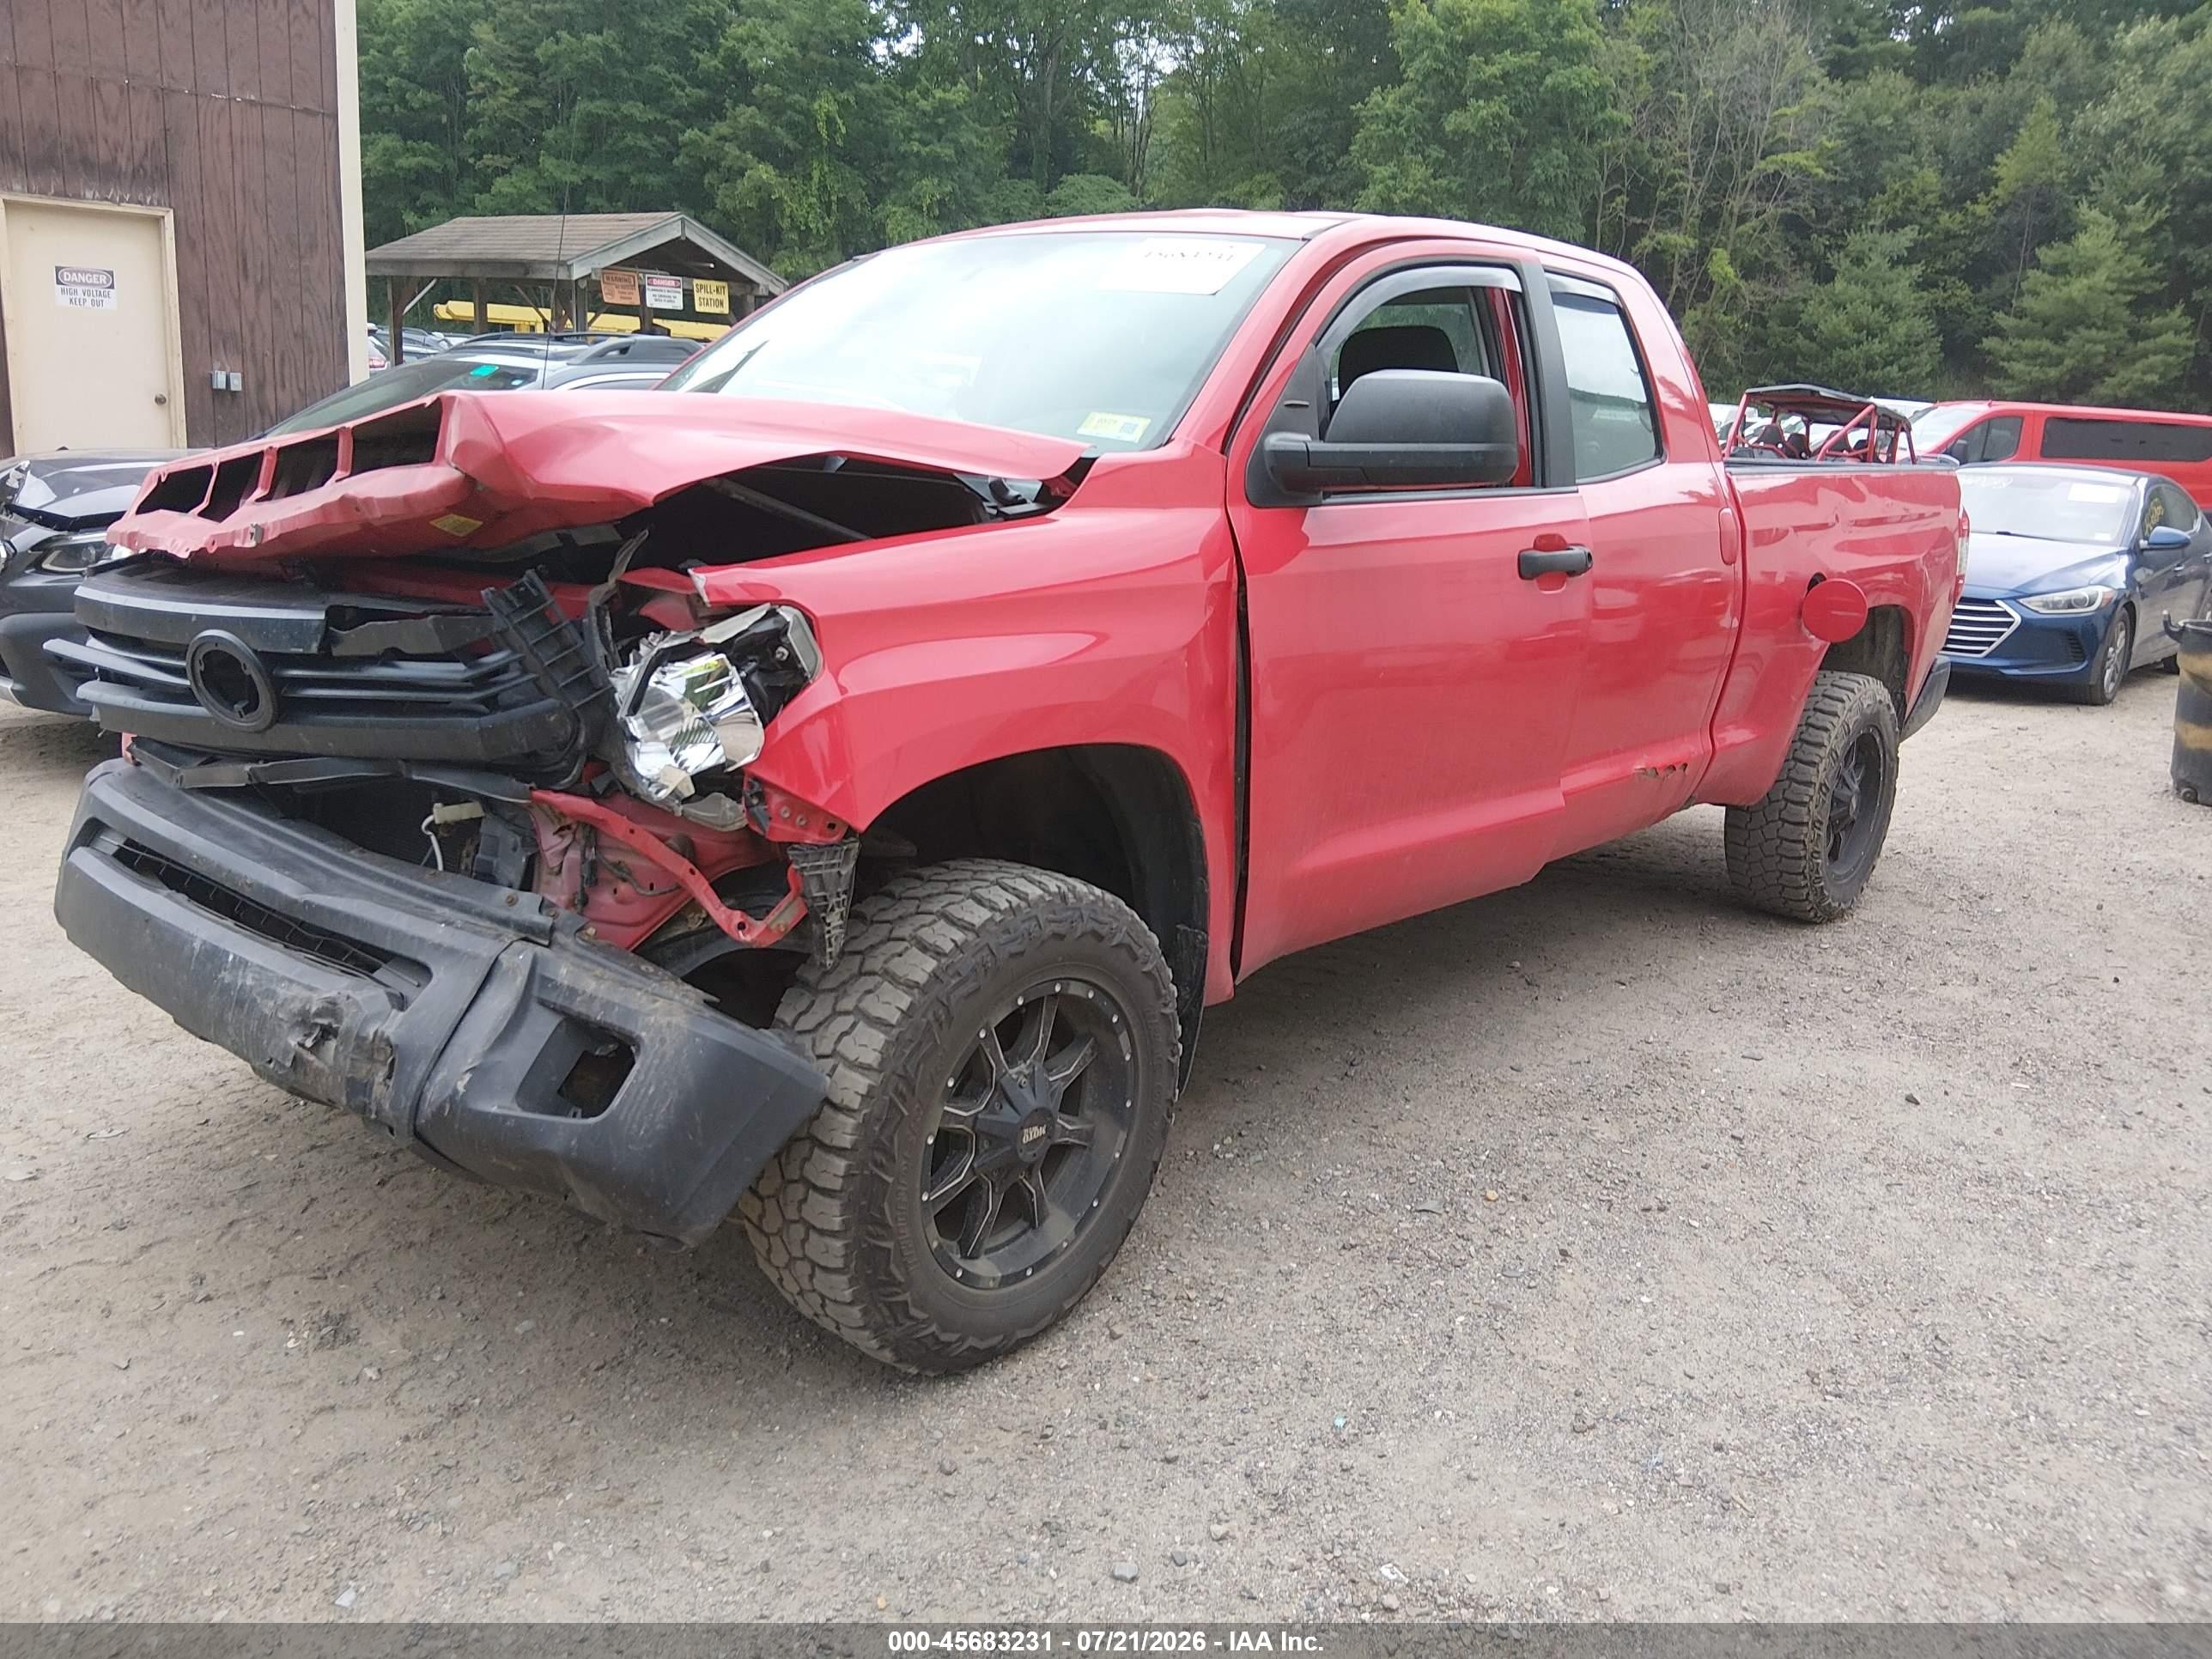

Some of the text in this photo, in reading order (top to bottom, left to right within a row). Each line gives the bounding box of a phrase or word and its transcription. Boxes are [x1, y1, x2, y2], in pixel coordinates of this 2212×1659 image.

[64, 272, 106, 284] DANGER
[605, 275, 632, 284] WARNING
[61, 287, 111, 298] HIGH VOLTAGE
[696, 283, 726, 295] SPILL-KIT
[70, 297, 104, 307] KEEP OUT
[698, 296, 725, 309] STATION
